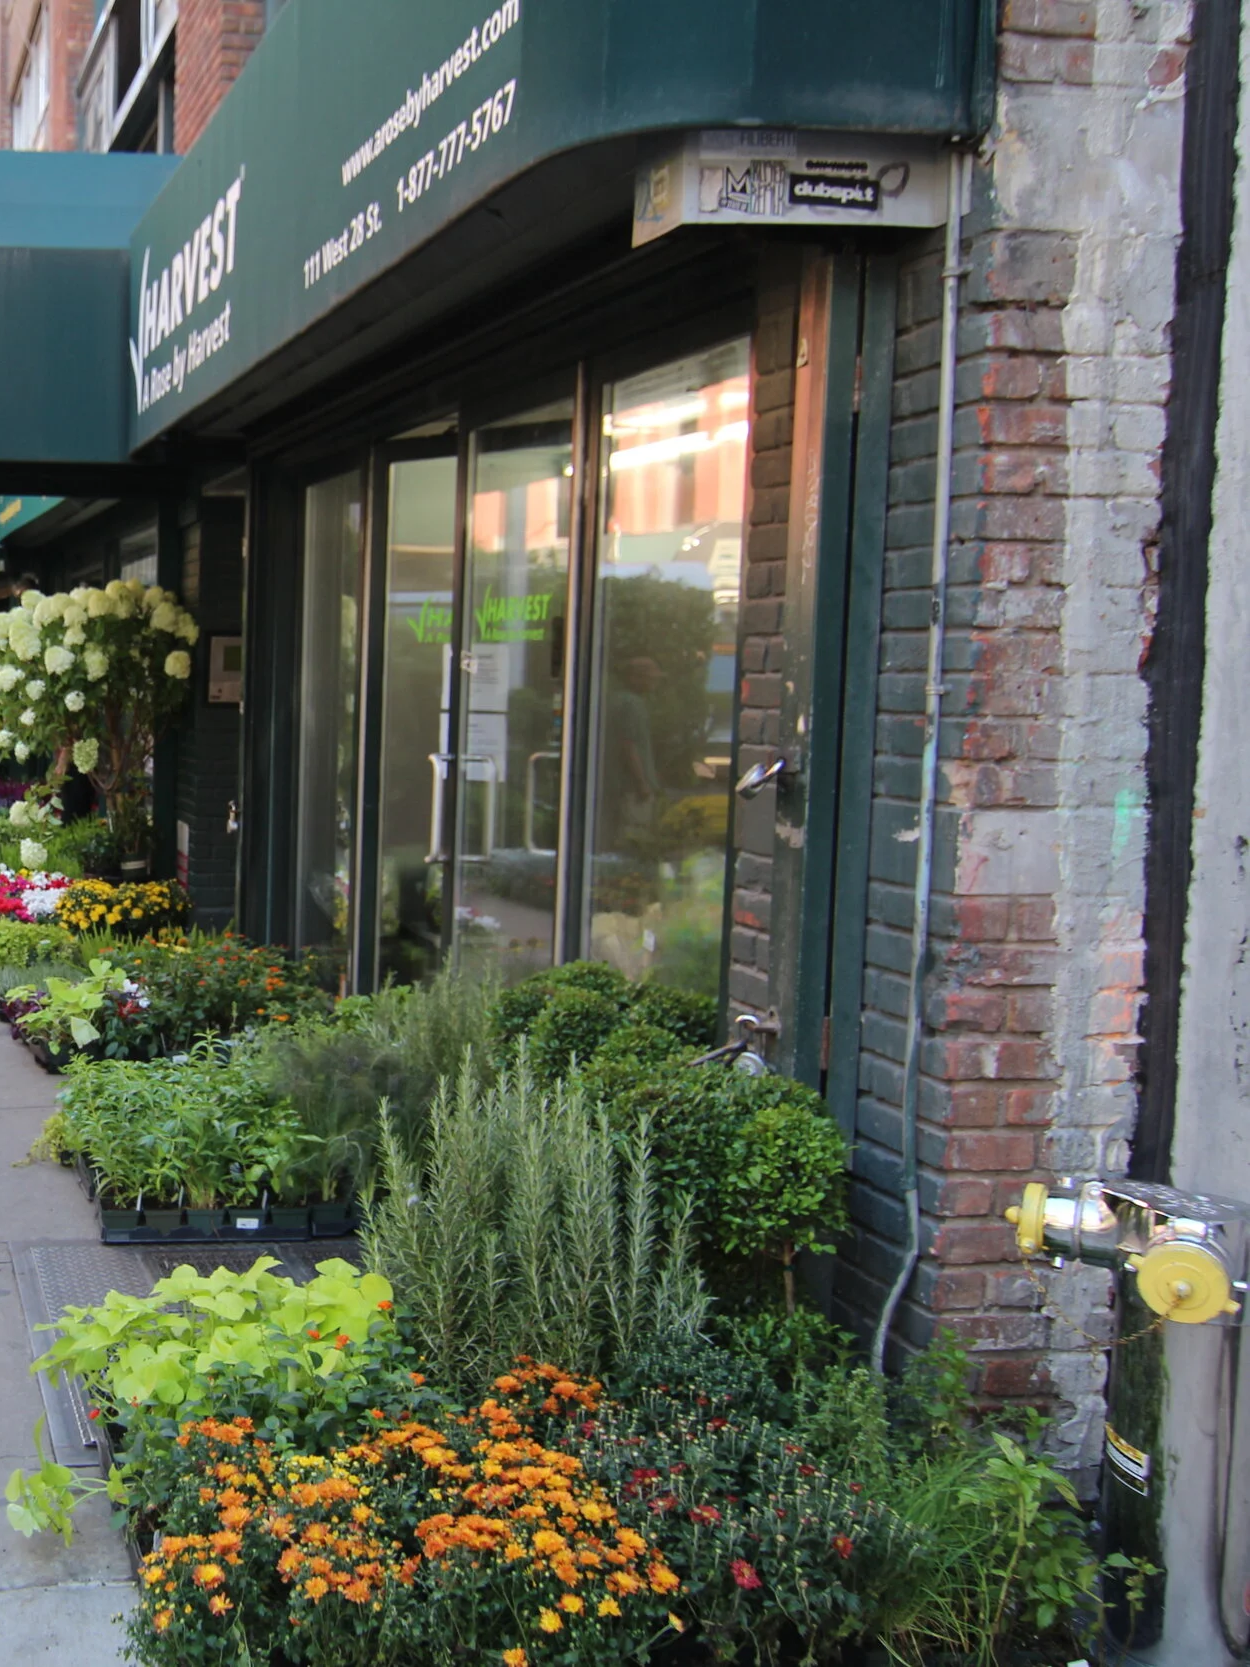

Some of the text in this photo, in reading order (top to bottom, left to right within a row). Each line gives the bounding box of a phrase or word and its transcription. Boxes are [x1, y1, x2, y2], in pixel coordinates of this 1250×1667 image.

[303, 78, 517, 289] 111 West 28 St. 1-877-777-5767
[342, 0, 519, 187] www.arosebyharvest.com
[141, 299, 231, 413] A Rose by Harvest
[143, 177, 241, 359] HARVEST
[488, 593, 553, 623] HARVEST
